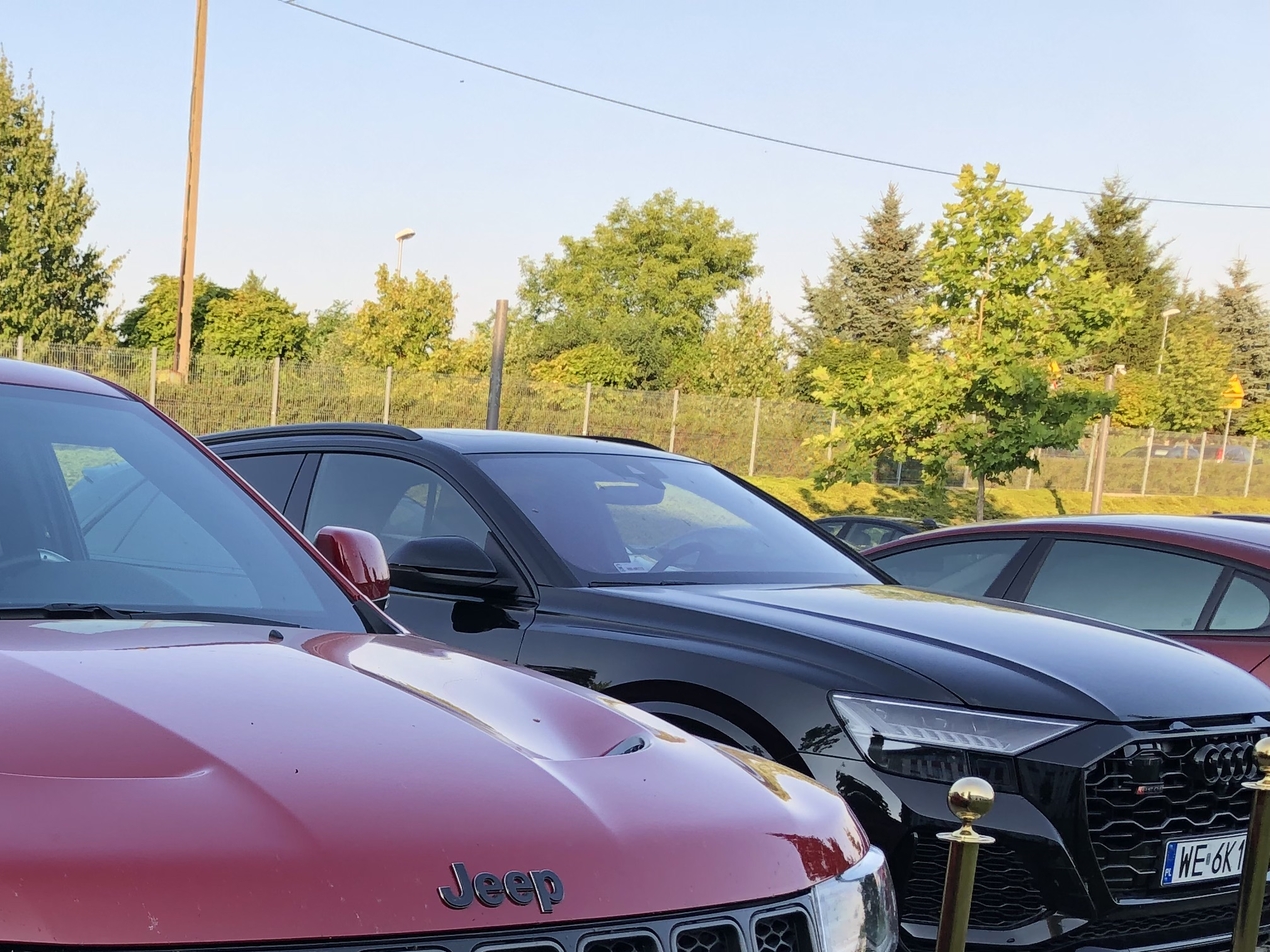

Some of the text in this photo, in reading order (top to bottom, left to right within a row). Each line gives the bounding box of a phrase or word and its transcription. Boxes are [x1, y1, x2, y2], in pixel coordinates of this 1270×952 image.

[1178, 844, 1208, 879] WE
[1212, 839, 1246, 874] 6K1
[437, 861, 564, 914] Jeep
